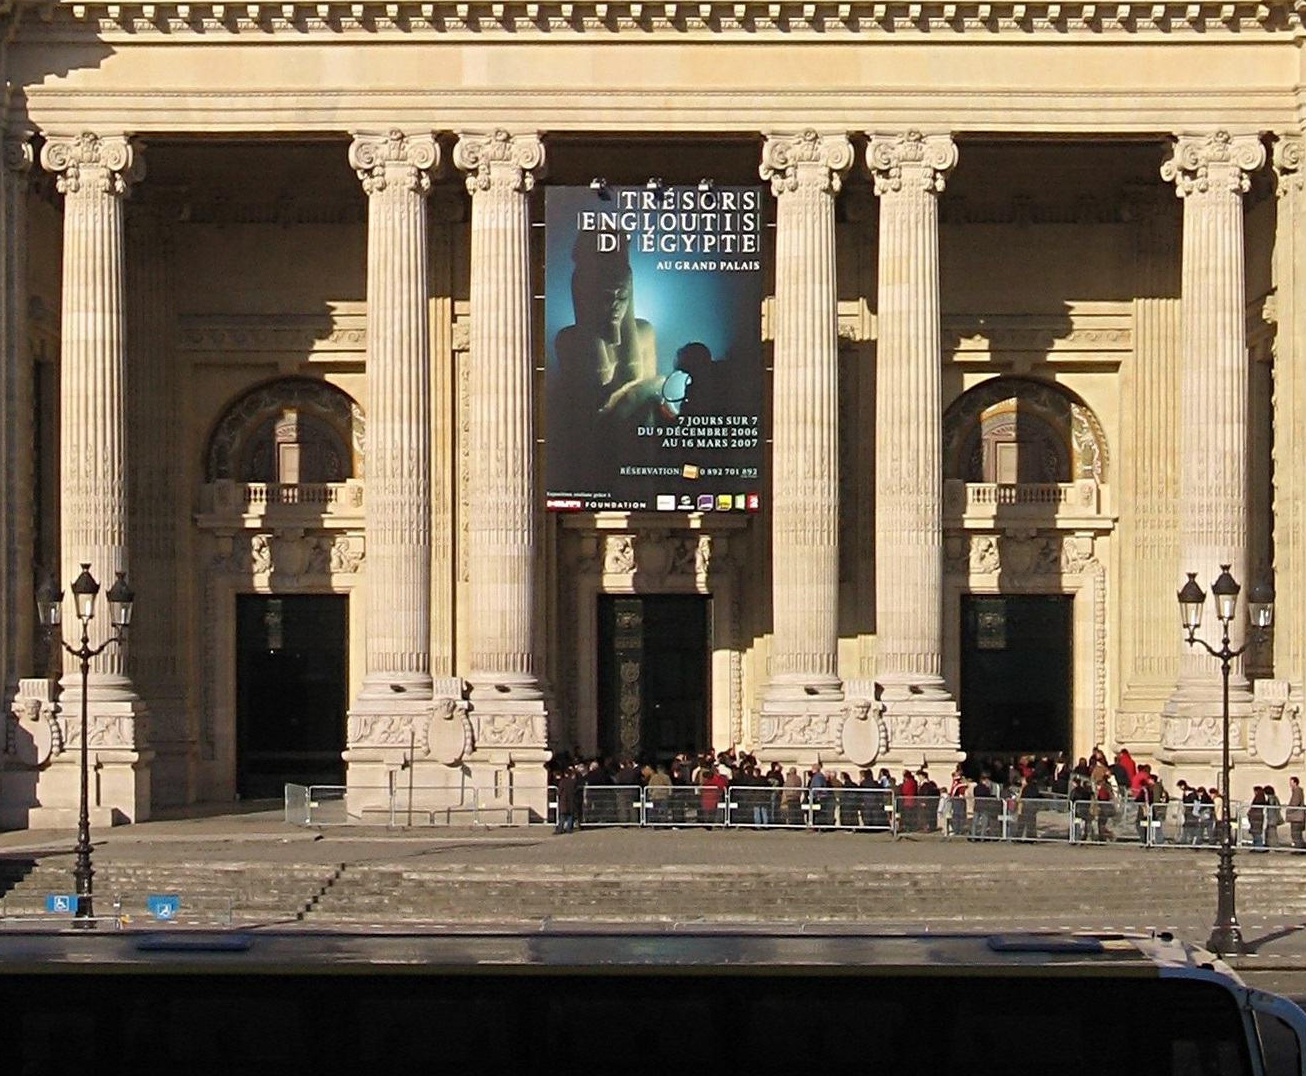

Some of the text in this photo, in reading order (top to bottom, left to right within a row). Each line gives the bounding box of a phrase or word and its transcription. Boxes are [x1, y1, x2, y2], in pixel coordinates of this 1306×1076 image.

[621, 188, 756, 210] TRÉSORS
[582, 213, 756, 231] ENGLOUTIS
[600, 228, 757, 253] D'ÉGYPTE
[657, 262, 760, 271] AU GRAND PALAIS
[678, 417, 758, 426] 7 JOURS SUR 7
[637, 426, 758, 436] DU 9 DÉCEMBRE 2006
[662, 439, 758, 448] AU 16 MARS 2007
[585, 501, 646, 509] FOUNDATION
